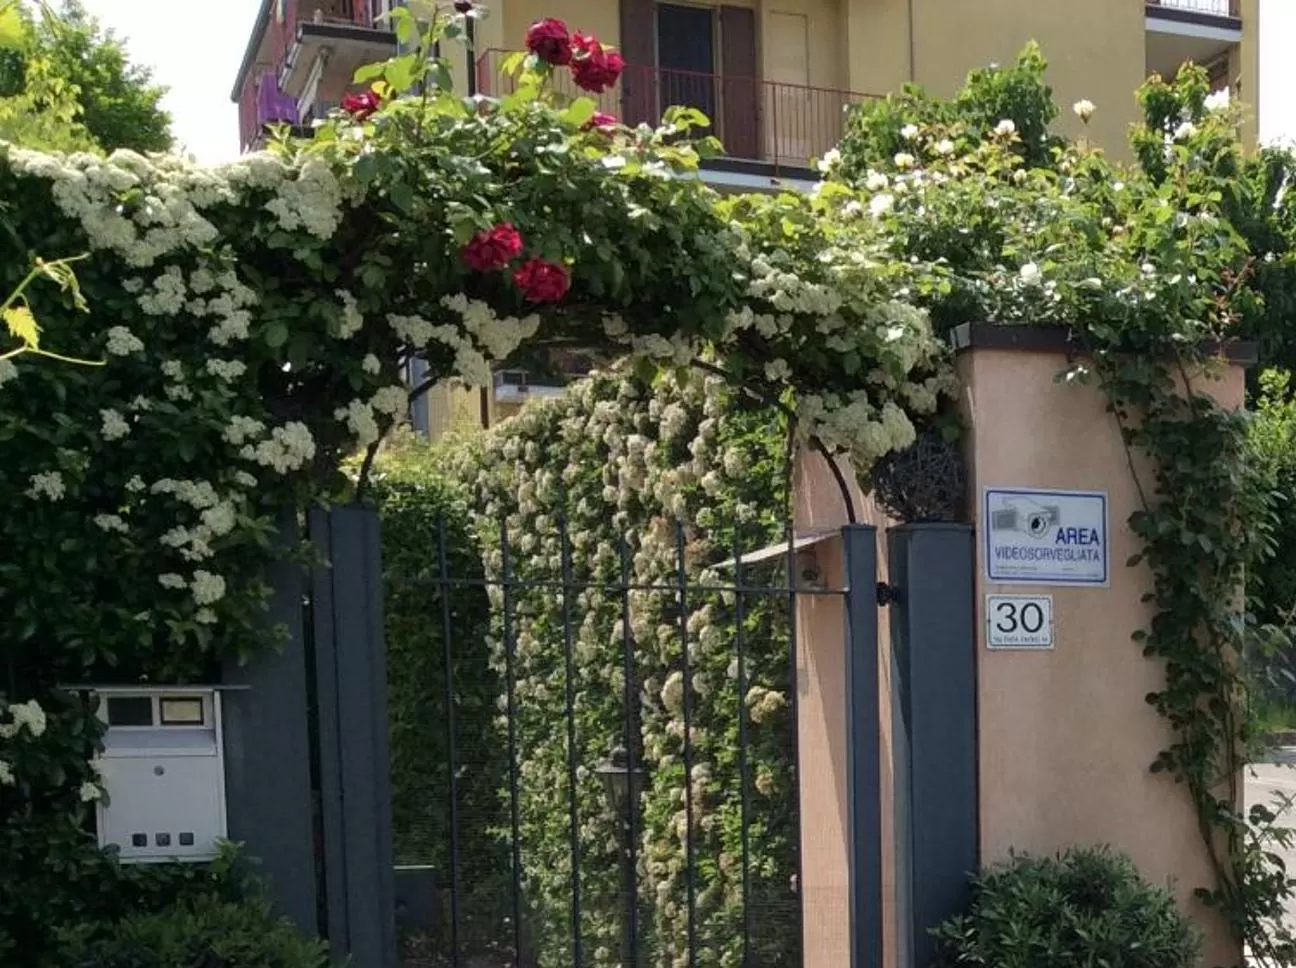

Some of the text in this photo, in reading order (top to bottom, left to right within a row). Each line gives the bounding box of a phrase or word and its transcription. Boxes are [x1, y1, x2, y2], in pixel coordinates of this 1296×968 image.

[1055, 527, 1100, 546] AREA
[994, 546, 1100, 562] VIDEOSORVEGLIATA
[996, 602, 1044, 633] 30
